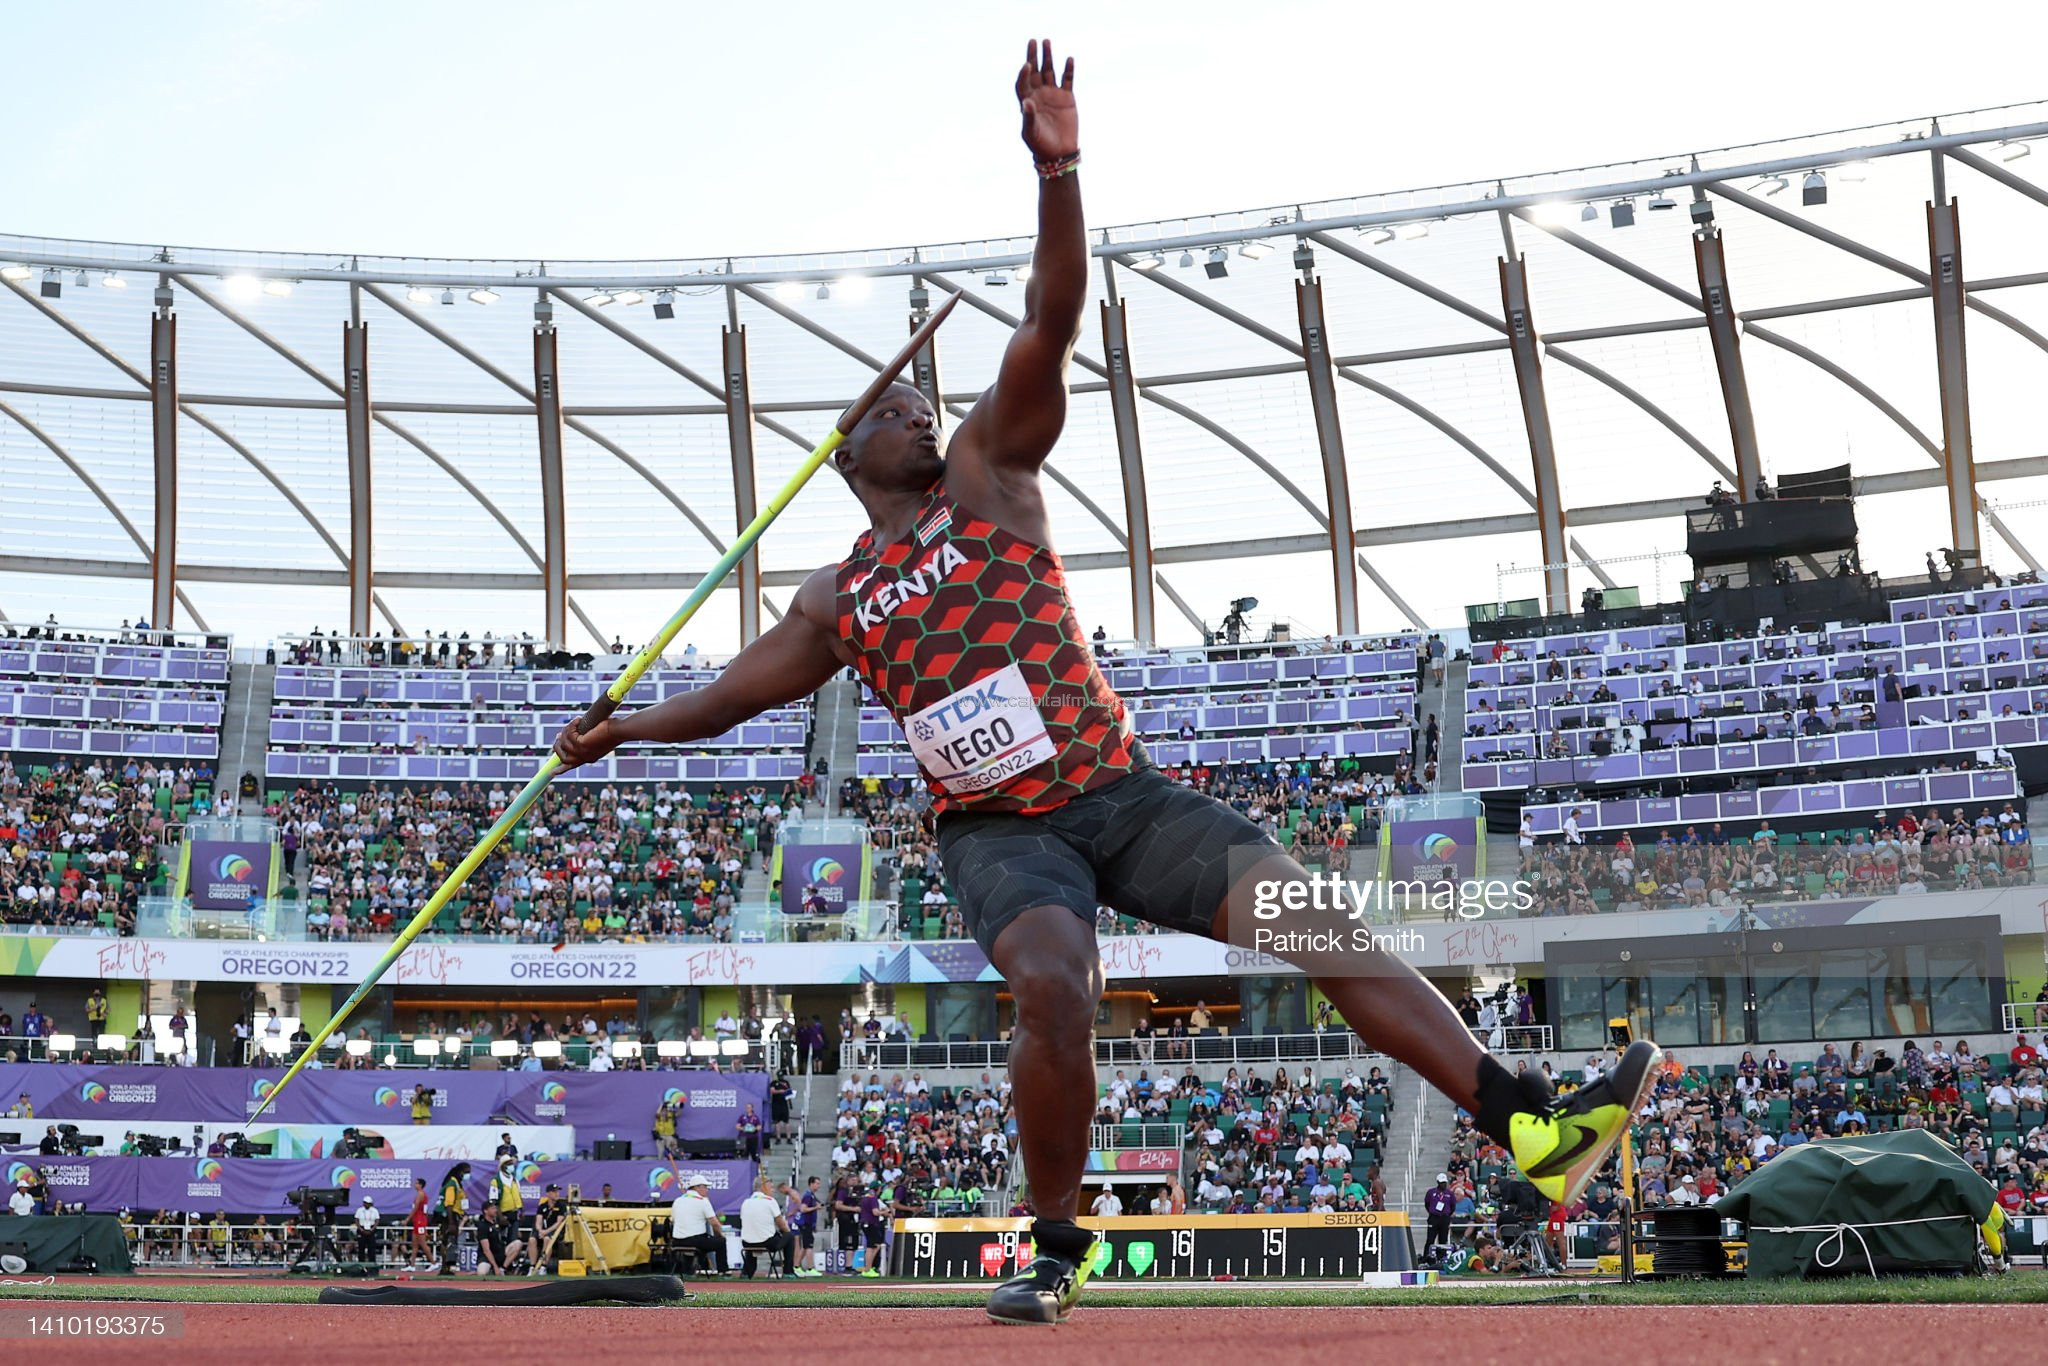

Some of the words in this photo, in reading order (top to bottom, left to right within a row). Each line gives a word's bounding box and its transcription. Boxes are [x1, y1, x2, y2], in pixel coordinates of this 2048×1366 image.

[856, 542, 968, 632] KENYA
[927, 680, 1009, 732] TDK
[935, 717, 1015, 771] YEGO
[956, 749, 1036, 790] OREGON22
[47, 1177, 90, 1186] REGON22
[360, 1180, 412, 1189] OREGON22
[587, 1218, 648, 1235] SEIKO
[1324, 1214, 1377, 1225] SEIKO
[914, 1233, 932, 1258] 19
[984, 1247, 1003, 1261] WR
[997, 1232, 1016, 1258] 18
[1171, 1230, 1191, 1257] 16
[1262, 1229, 1283, 1256] 15
[1357, 1227, 1378, 1255] 14
[837, 1252, 845, 1266] 6
